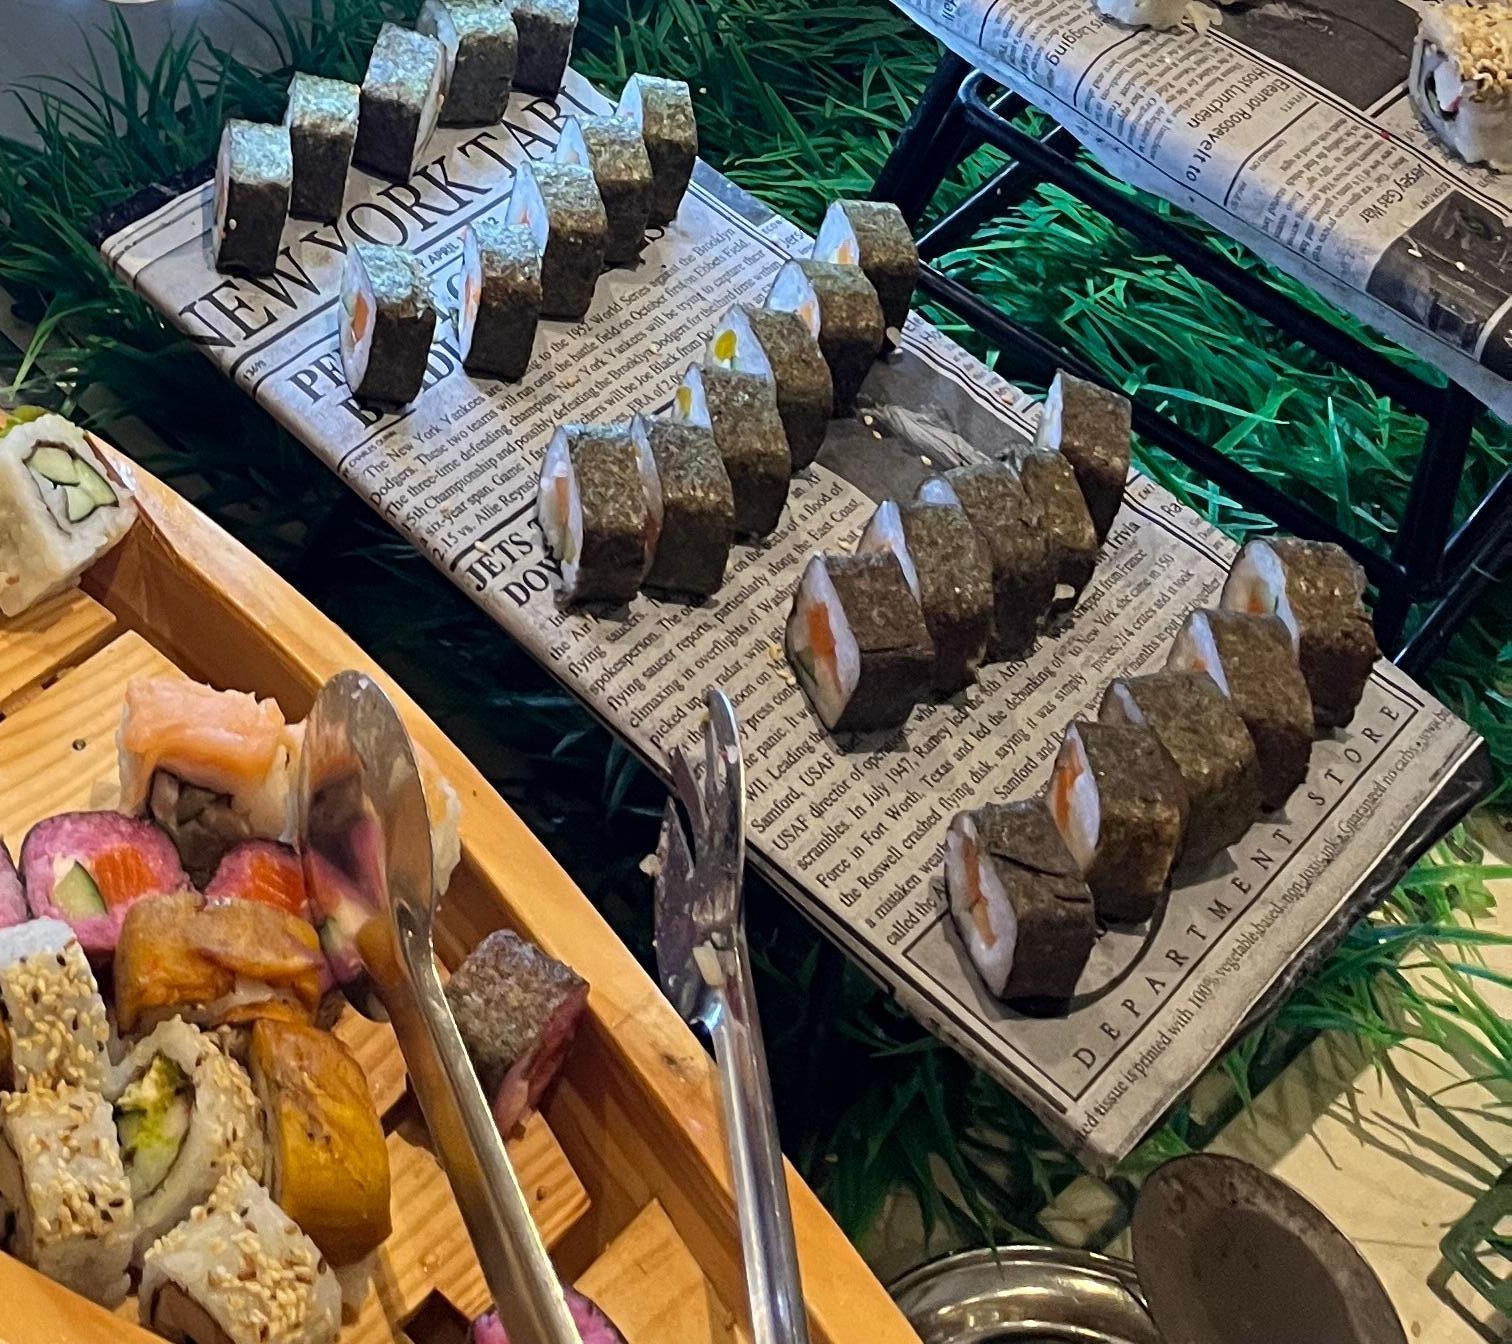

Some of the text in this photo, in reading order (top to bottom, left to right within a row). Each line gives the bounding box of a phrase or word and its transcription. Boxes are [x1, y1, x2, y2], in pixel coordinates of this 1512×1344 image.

[1044, 21, 1096, 68] Lagging
[1181, 73, 1290, 184] Eleanor Roosevelt to
[1185, 61, 1267, 133] Host Luncheon
[1356, 159, 1429, 226] Jersey Gas War
[178, 246, 322, 349] NEW
[299, 155, 493, 253] YORK
[361, 456, 390, 480] The
[386, 439, 416, 463] New
[411, 420, 443, 445] York
[439, 391, 486, 428] Yankees
[566, 319, 594, 343] 1952
[589, 299, 623, 328] World
[618, 280, 652, 308] Series
[692, 223, 737, 261] Brooklyn
[414, 439, 448, 467] These
[445, 428, 470, 449] two
[628, 290, 668, 323] October
[406, 455, 462, 499] three-time
[457, 420, 514, 466] defending
[421, 382, 599, 514] Championship possibly defeating
[423, 500, 473, 540] six-year
[490, 459, 525, 488] Game
[649, 348, 681, 377] Black
[471, 468, 545, 526] Allie Reynold
[459, 528, 536, 593] JETS
[581, 625, 666, 696] spokesperson.
[603, 675, 648, 713] flying
[639, 647, 679, 681] saucer
[673, 617, 718, 655] reports,
[709, 570, 773, 624] particularly
[763, 549, 800, 580] along
[806, 518, 835, 542] East
[622, 619, 753, 731] climaxing overflights
[764, 736, 817, 783] Leading
[797, 751, 839, 789] USAF
[860, 778, 894, 810] July
[910, 721, 956, 762] Ramey
[918, 662, 1057, 791] Texas debunking
[854, 669, 1092, 891] Roswell flying saying simply
[1070, 702, 1403, 1072] DEPARTMENT STORE
[1128, 1028, 1177, 1079] printed
[1161, 1003, 1195, 1038] with
